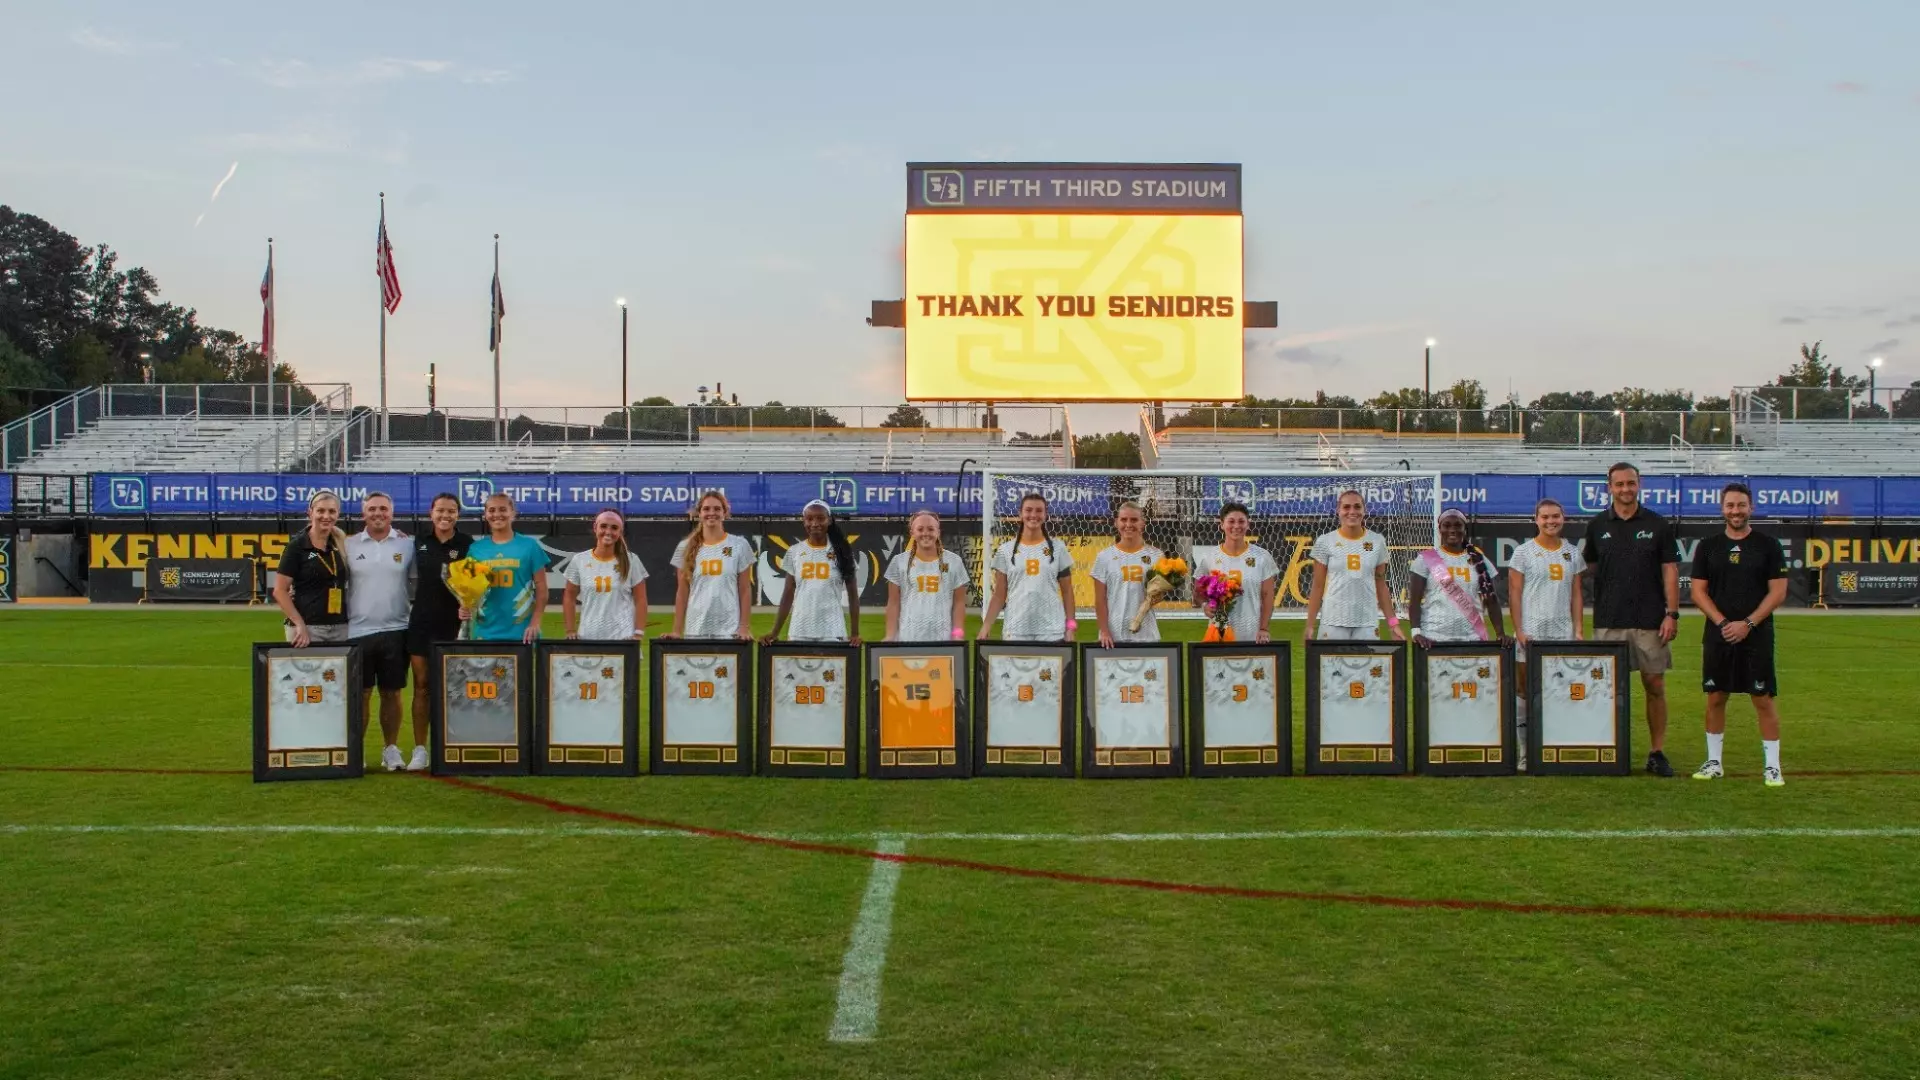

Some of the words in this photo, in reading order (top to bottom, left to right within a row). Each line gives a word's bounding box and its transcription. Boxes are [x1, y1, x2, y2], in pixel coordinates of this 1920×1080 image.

[973, 179, 1041, 197] FIFTH
[1051, 179, 1122, 198] THIRD
[1131, 180, 1226, 198] STADIUM
[916, 295, 1024, 318] THANK
[1036, 295, 1096, 318] YOU
[1108, 295, 1234, 318] SENIORS
[152, 486, 209, 501] FIFTH
[217, 486, 278, 501] THIRD
[285, 486, 367, 502] STAIUM
[503, 487, 561, 502] FIFTH
[569, 487, 633, 502] THIRD
[865, 487, 925, 502] FIFTH
[1331, 487, 1395, 503] TIRD
[1637, 489, 1680, 504] FTH
[1688, 489, 1721, 504] THI
[1757, 490, 1839, 505] STADIUM
[700, 560, 723, 576] 10
[802, 562, 831, 580] 20
[1026, 559, 1040, 576] 8
[1347, 554, 1361, 571] 6
[1120, 565, 1144, 582] 12
[1549, 563, 1564, 581] 9
[594, 575, 612, 593] 11
[916, 575, 940, 593] 15
[295, 685, 323, 704] 15
[466, 680, 498, 700] 00
[579, 682, 598, 700] 11
[688, 681, 714, 699] 10
[795, 685, 825, 704] 20
[904, 683, 931, 701] 15
[1119, 685, 1145, 704] 12
[1232, 684, 1248, 702] 3
[1349, 681, 1365, 699] 6
[1451, 681, 1477, 699] 14
[1569, 683, 1586, 701] 9
